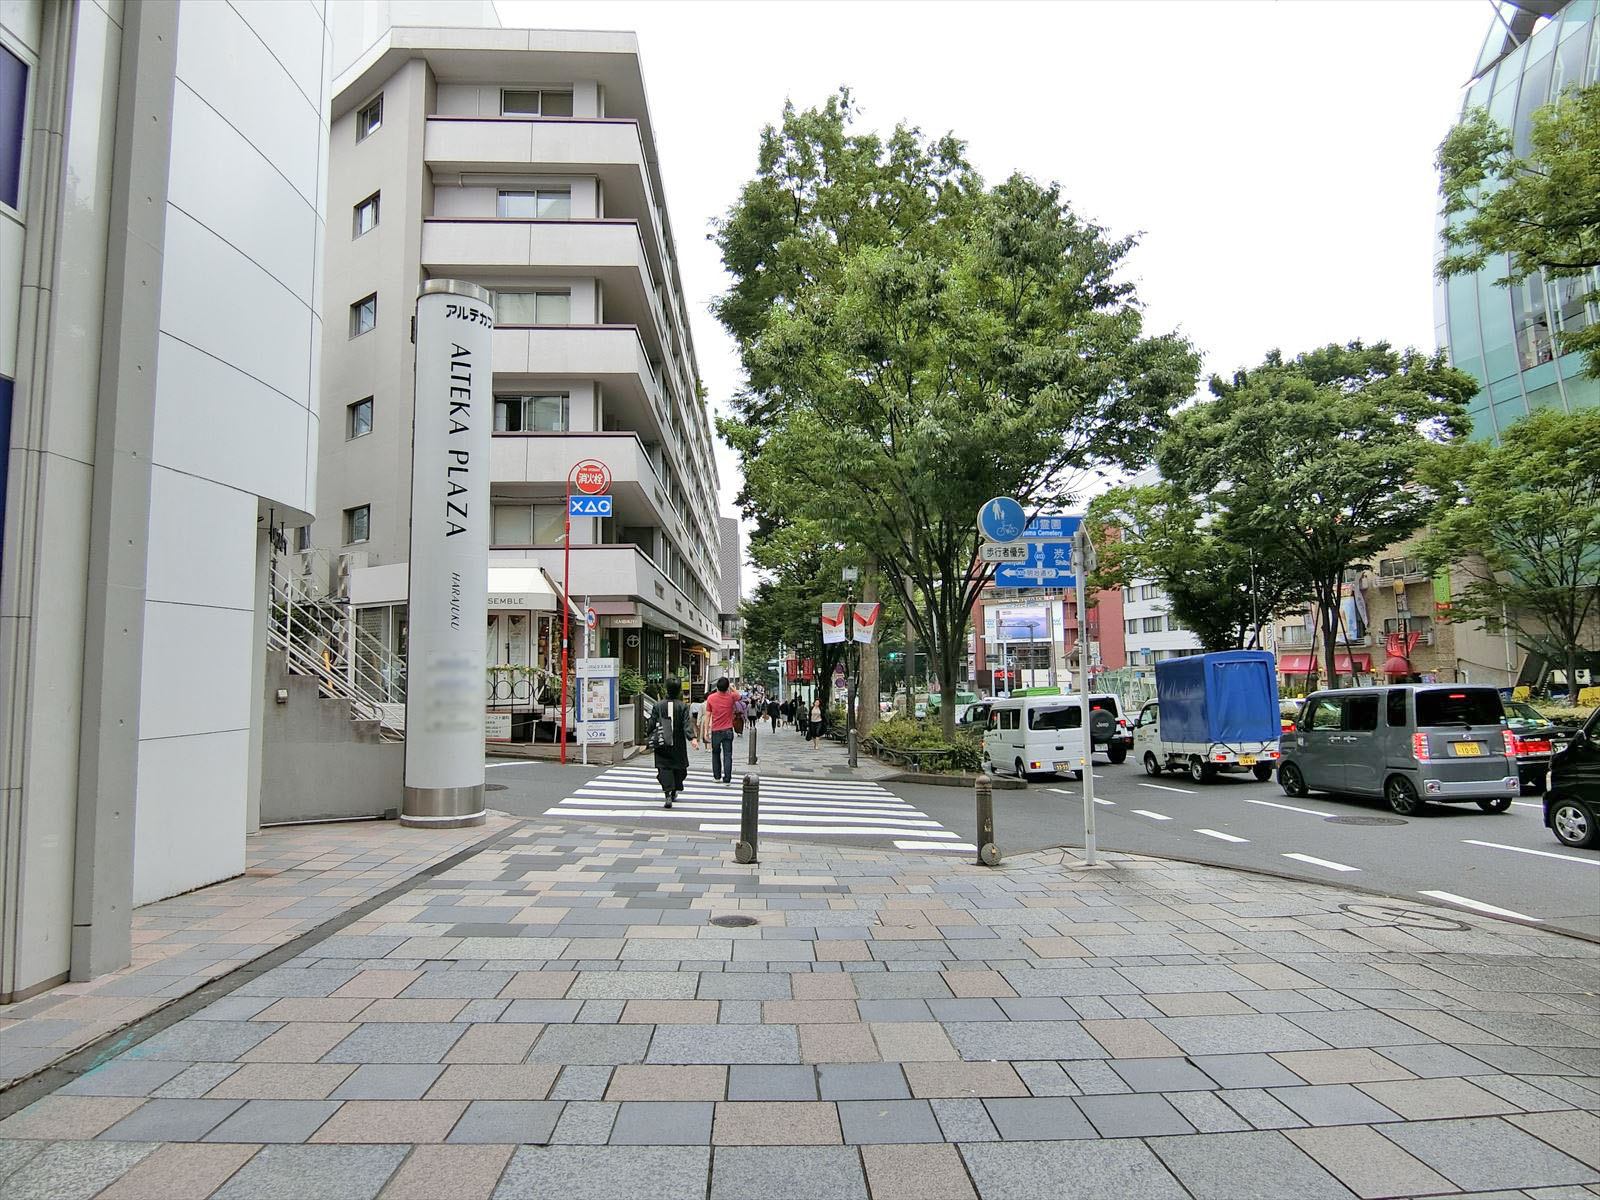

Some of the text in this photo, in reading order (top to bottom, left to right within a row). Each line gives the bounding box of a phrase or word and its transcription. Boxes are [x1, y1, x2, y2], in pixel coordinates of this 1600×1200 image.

[446, 342, 472, 537] ALTEKA PLAZA
[578, 473, 603, 485] 消火栓
[986, 547, 1026, 558] 歩行者優先
[450, 572, 461, 631] HARAJUKU
[487, 597, 525, 605] SEMBLE
